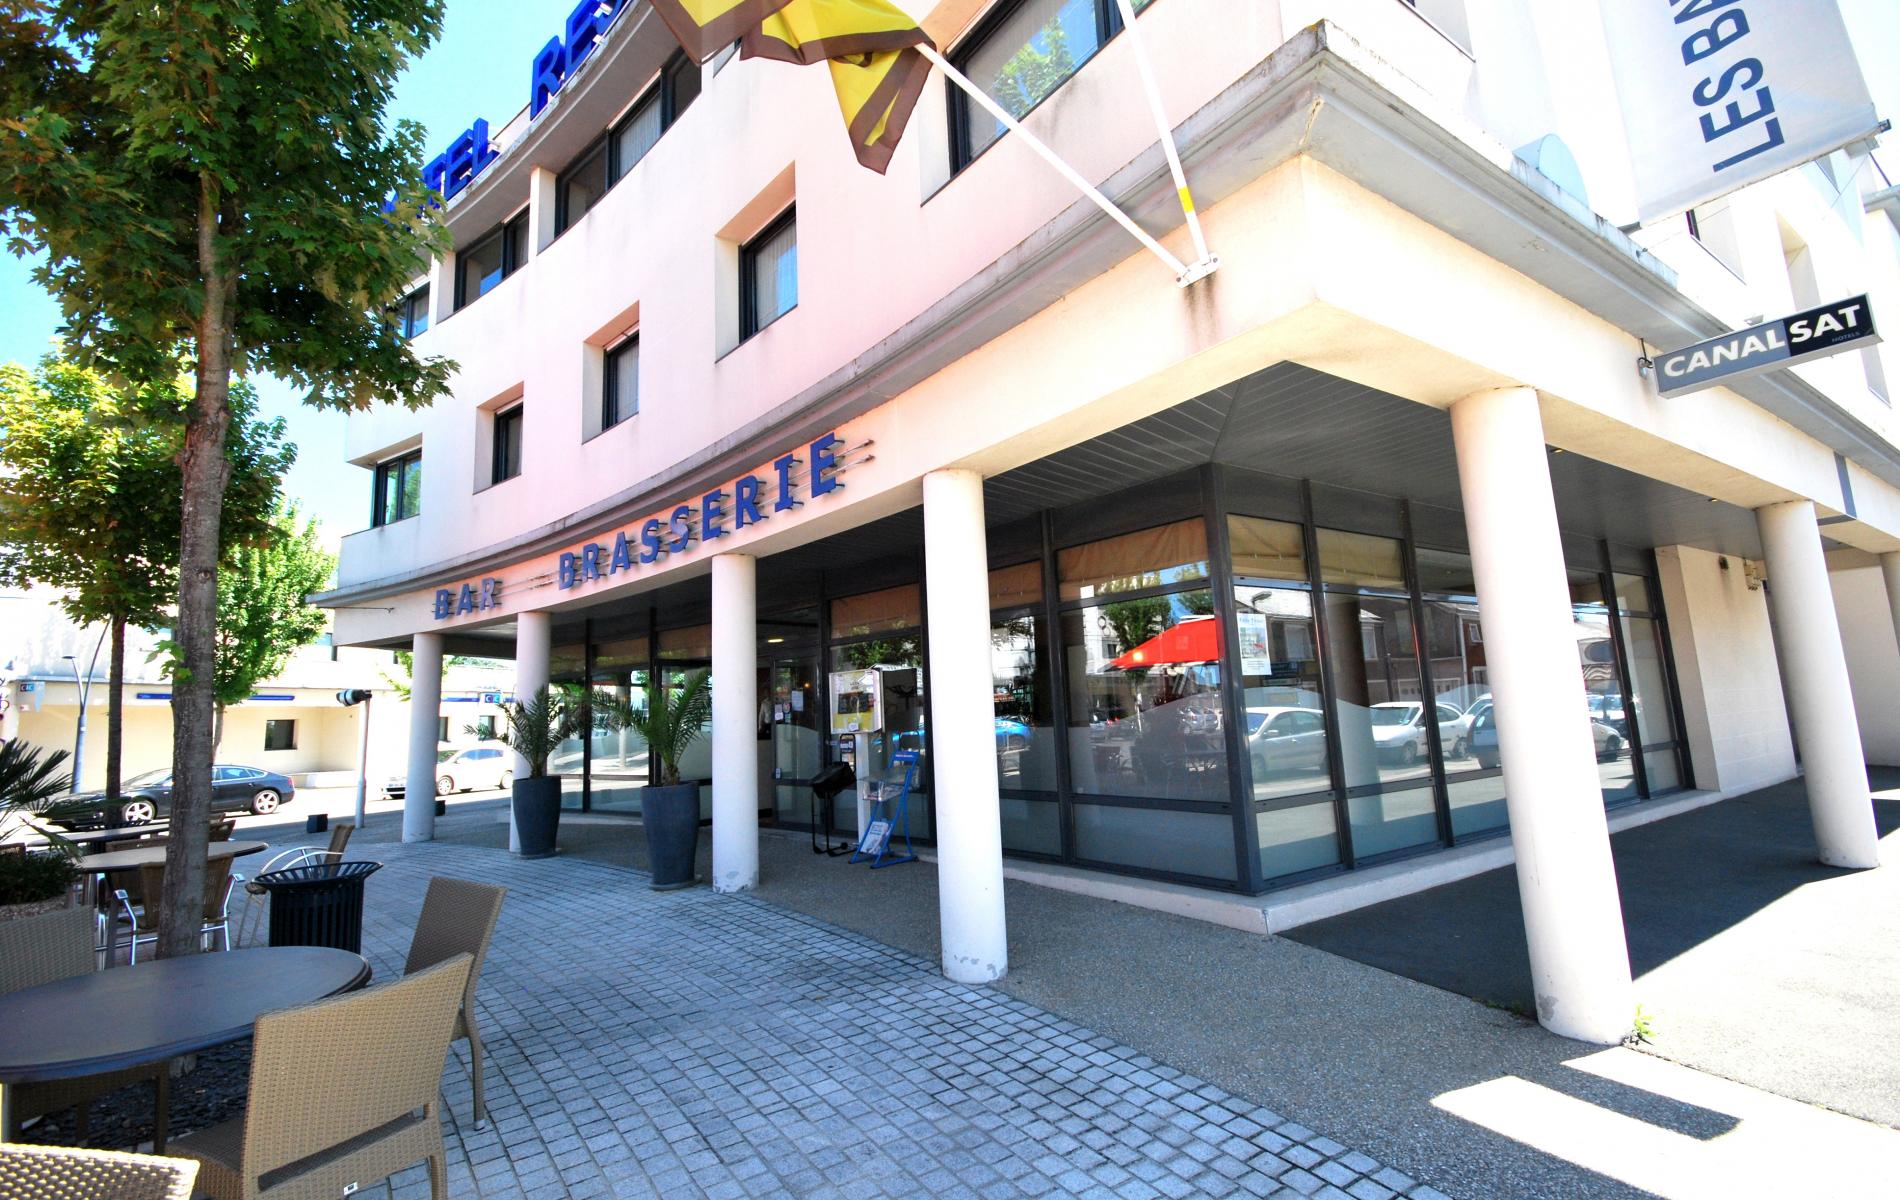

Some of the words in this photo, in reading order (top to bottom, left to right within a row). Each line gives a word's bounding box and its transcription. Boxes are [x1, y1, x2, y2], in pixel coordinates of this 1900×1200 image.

[1693, 58, 1785, 172] LES
[434, 576, 497, 620] BAR
[558, 432, 838, 591] BRASSERIE
